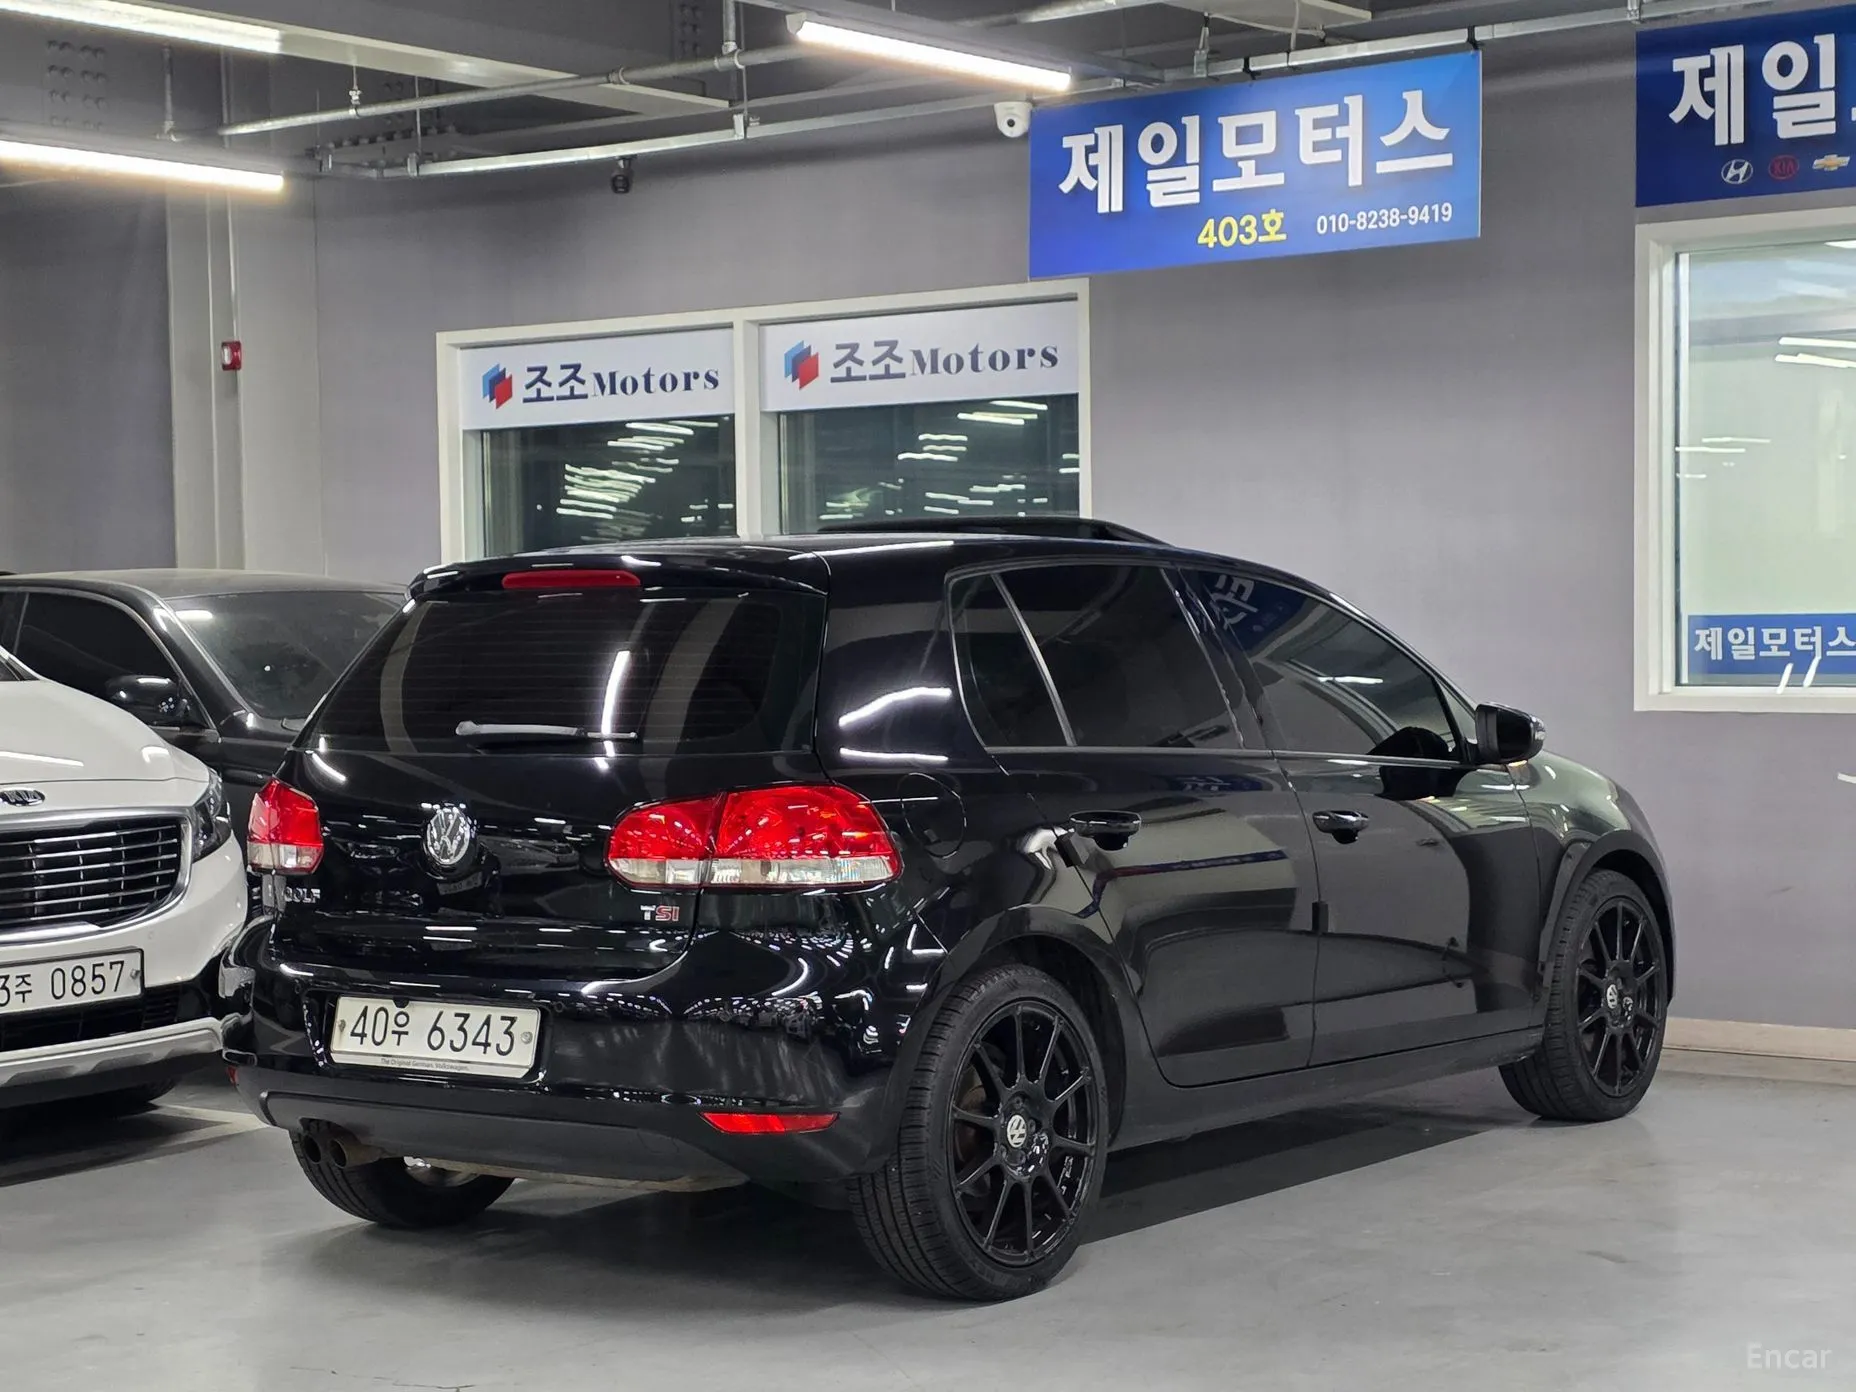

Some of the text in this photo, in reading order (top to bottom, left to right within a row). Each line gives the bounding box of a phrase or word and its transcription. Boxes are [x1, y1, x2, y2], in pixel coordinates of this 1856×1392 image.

[1669, 33, 1856, 146] 제일
[1058, 89, 1453, 214] 제일모터스
[1197, 202, 1452, 248] 403호 010-8238-9419
[830, 339, 1059, 383] 조조Motors
[522, 363, 719, 404] 조조Motors
[1694, 626, 1856, 660] 제일모터스
[640, 904, 680, 922] TSI
[50, 960, 125, 1000] 0857
[350, 1005, 518, 1056] 40우 6343
